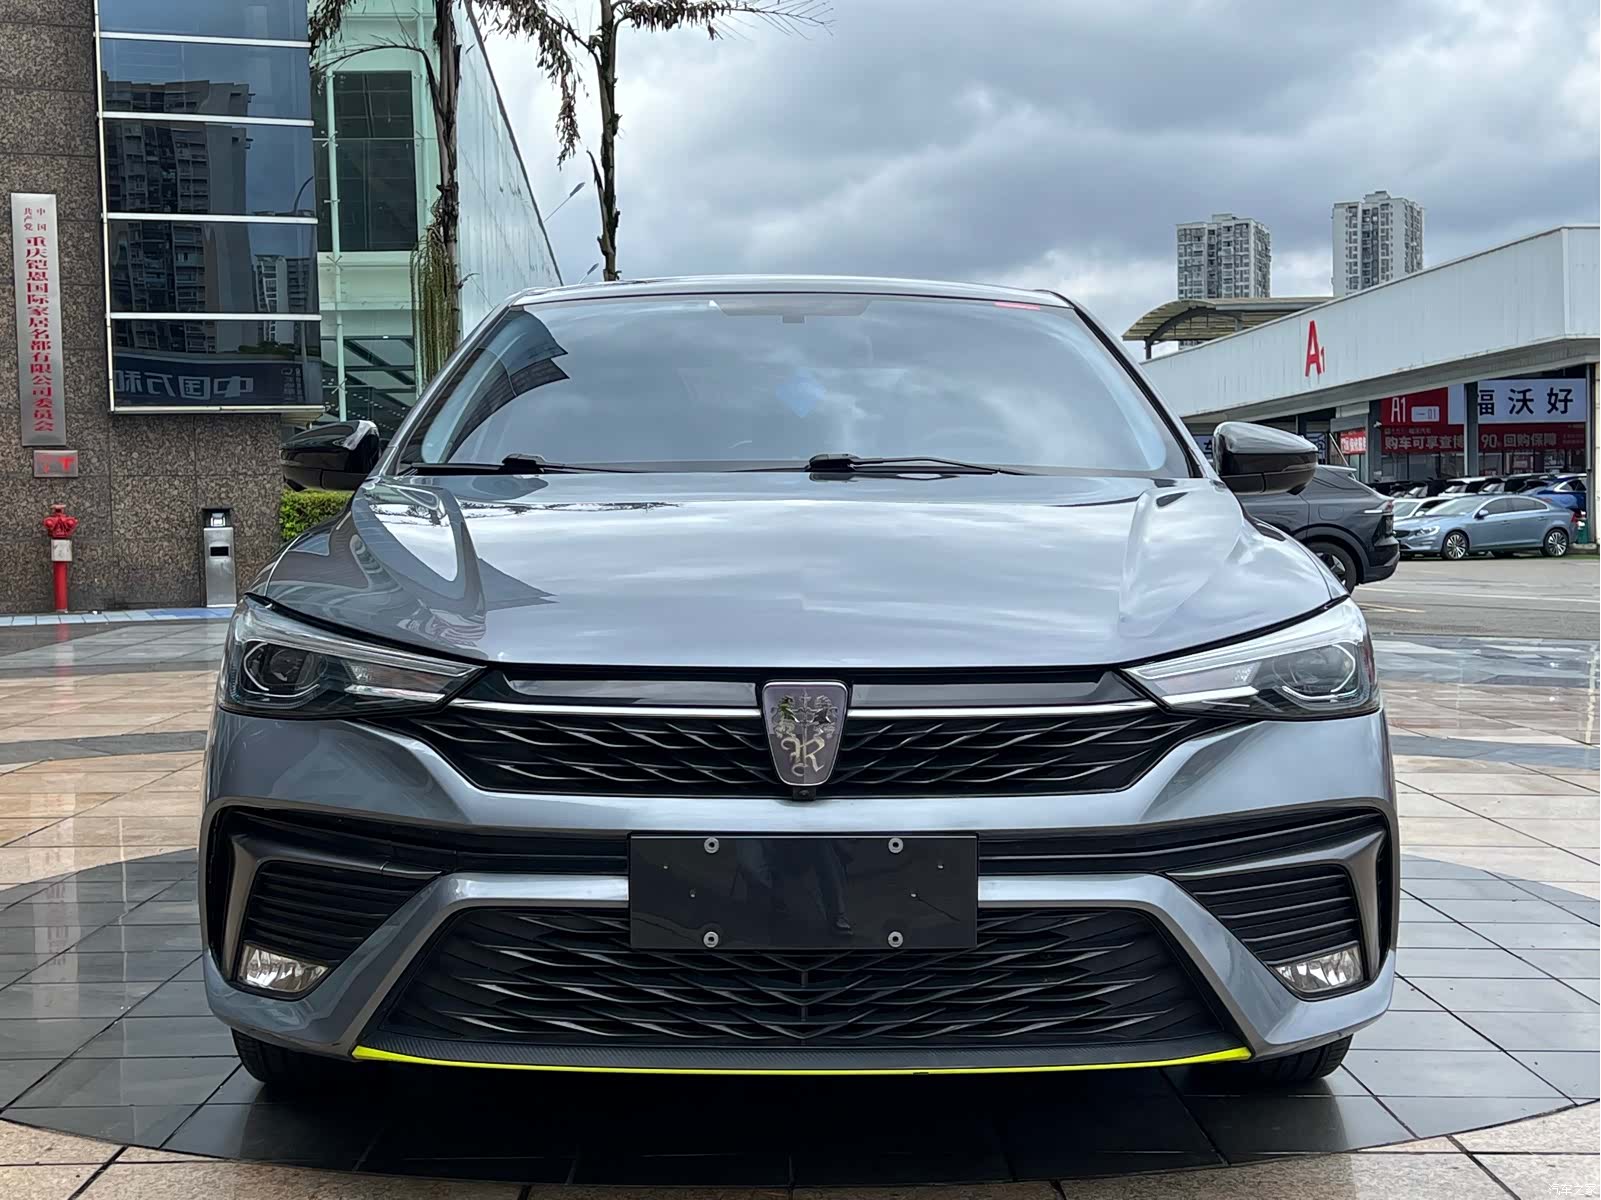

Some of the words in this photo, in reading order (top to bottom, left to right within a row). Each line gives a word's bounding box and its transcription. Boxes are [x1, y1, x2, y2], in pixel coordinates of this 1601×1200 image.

[23, 207, 34, 232] 共产党
[36, 207, 47, 232] 中国
[1304, 320, 1326, 378] A1
[1390, 396, 1406, 423] A1
